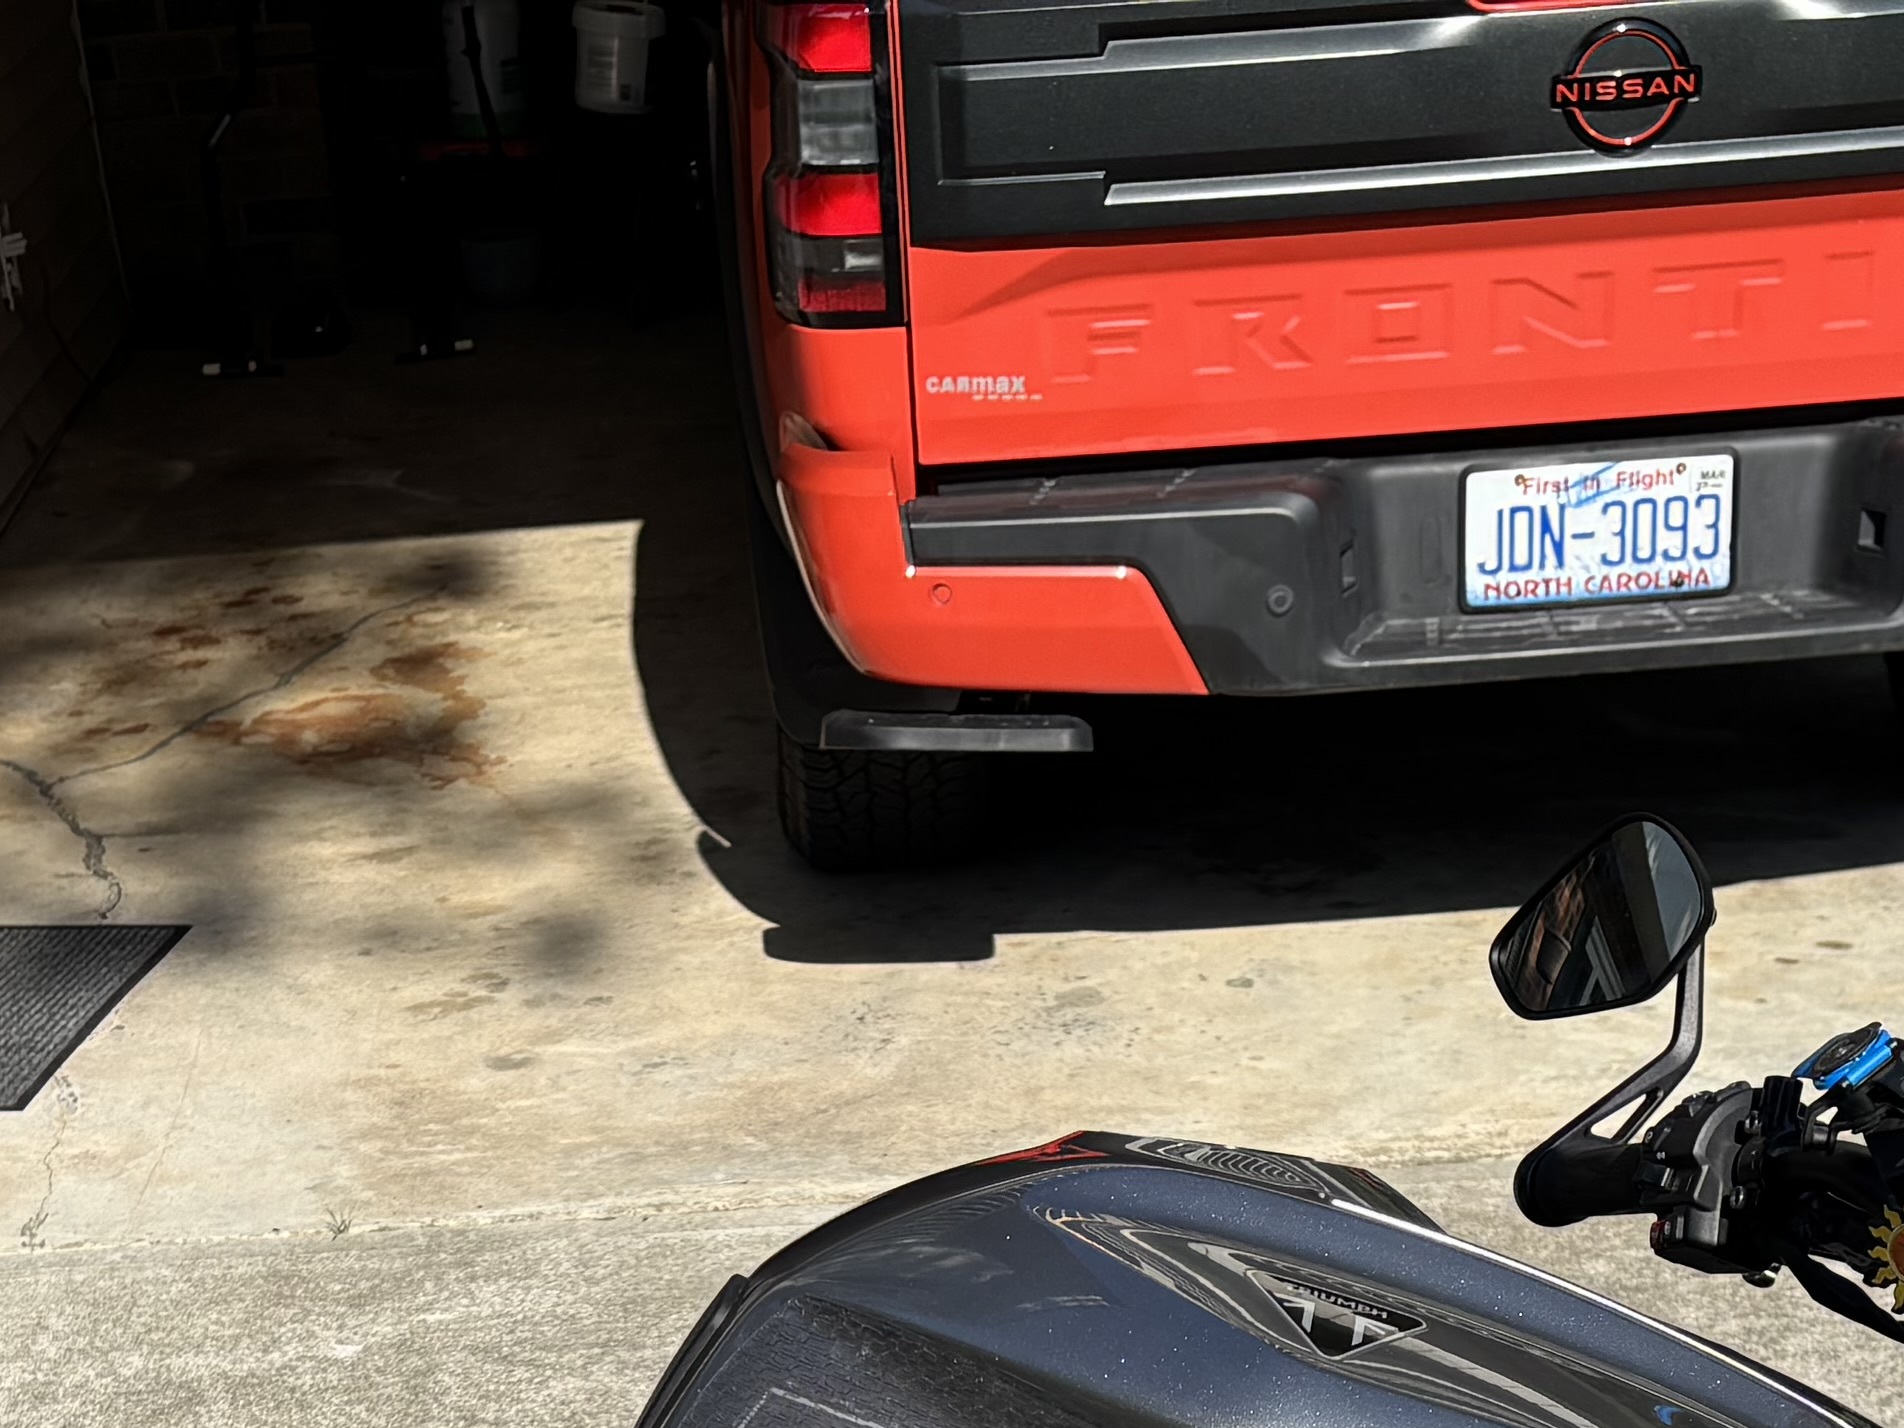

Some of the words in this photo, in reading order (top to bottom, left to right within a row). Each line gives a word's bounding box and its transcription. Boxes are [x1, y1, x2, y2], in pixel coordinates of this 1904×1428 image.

[1555, 73, 1696, 103] NISSAN
[1616, 467, 1676, 492] Flight
[1477, 493, 1722, 576] JDN-3093
[1483, 573, 1574, 602] NORTH
[1583, 566, 1711, 595] CAROLINA
